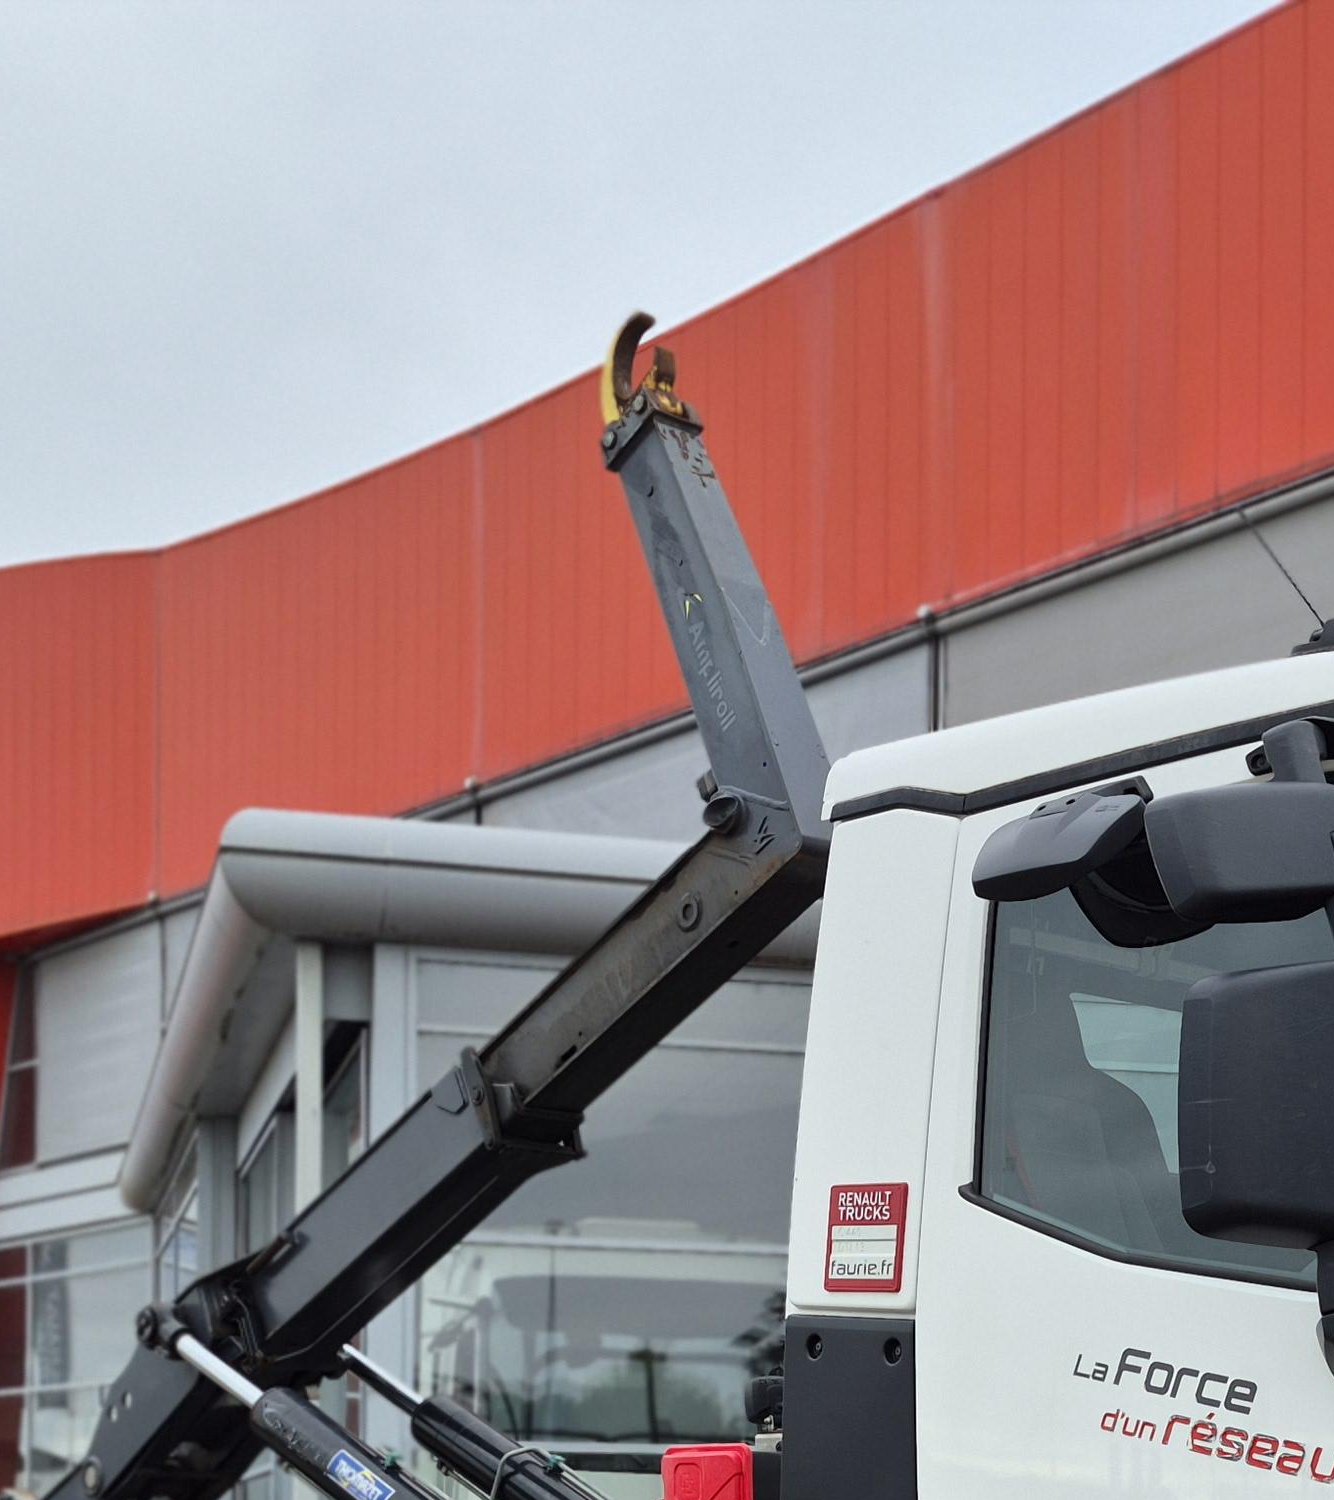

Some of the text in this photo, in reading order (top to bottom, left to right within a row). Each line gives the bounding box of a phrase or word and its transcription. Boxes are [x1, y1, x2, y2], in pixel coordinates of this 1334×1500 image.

[838, 1191, 892, 1207] RENAULT
[838, 1206, 890, 1221] TRUCKS
[831, 1259, 893, 1276] faurie.fr
[1073, 1348, 1258, 1415] La Force
